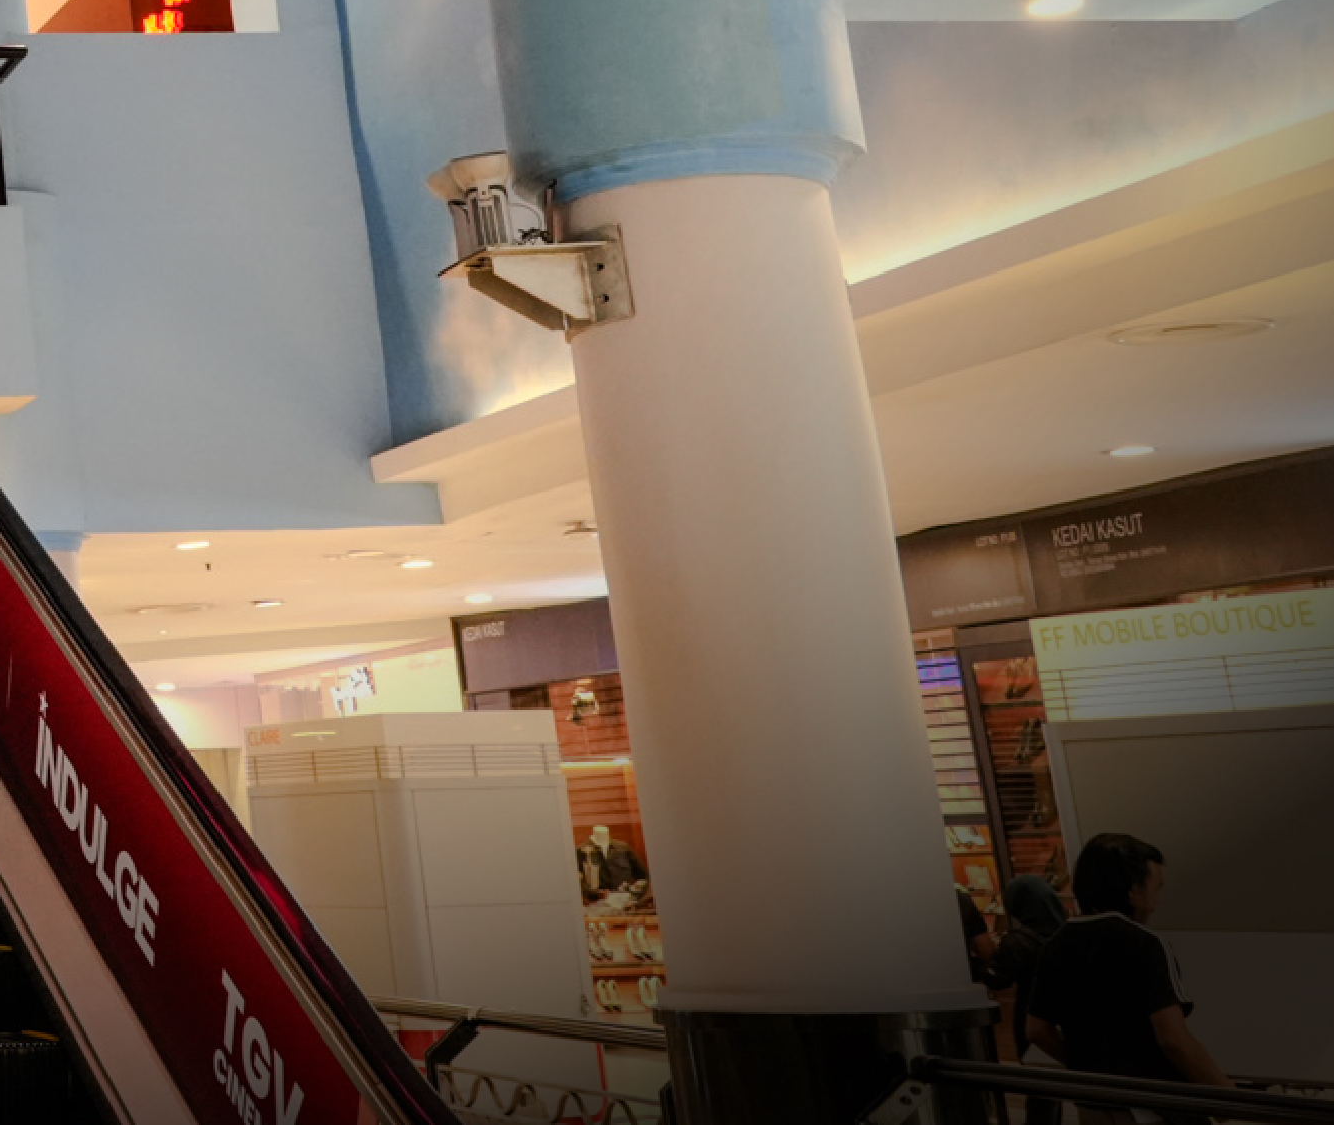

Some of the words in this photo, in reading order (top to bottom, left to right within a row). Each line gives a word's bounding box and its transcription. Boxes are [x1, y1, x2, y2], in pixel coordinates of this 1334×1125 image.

[1051, 521, 1095, 549] KEDAI
[1096, 511, 1143, 541] KASUT
[1038, 625, 1067, 652] FF
[1072, 614, 1169, 647] MOBILE
[1173, 600, 1317, 638] BOUTIQUE
[247, 727, 281, 747] CLAIRE
[221, 967, 305, 1125] TGV
